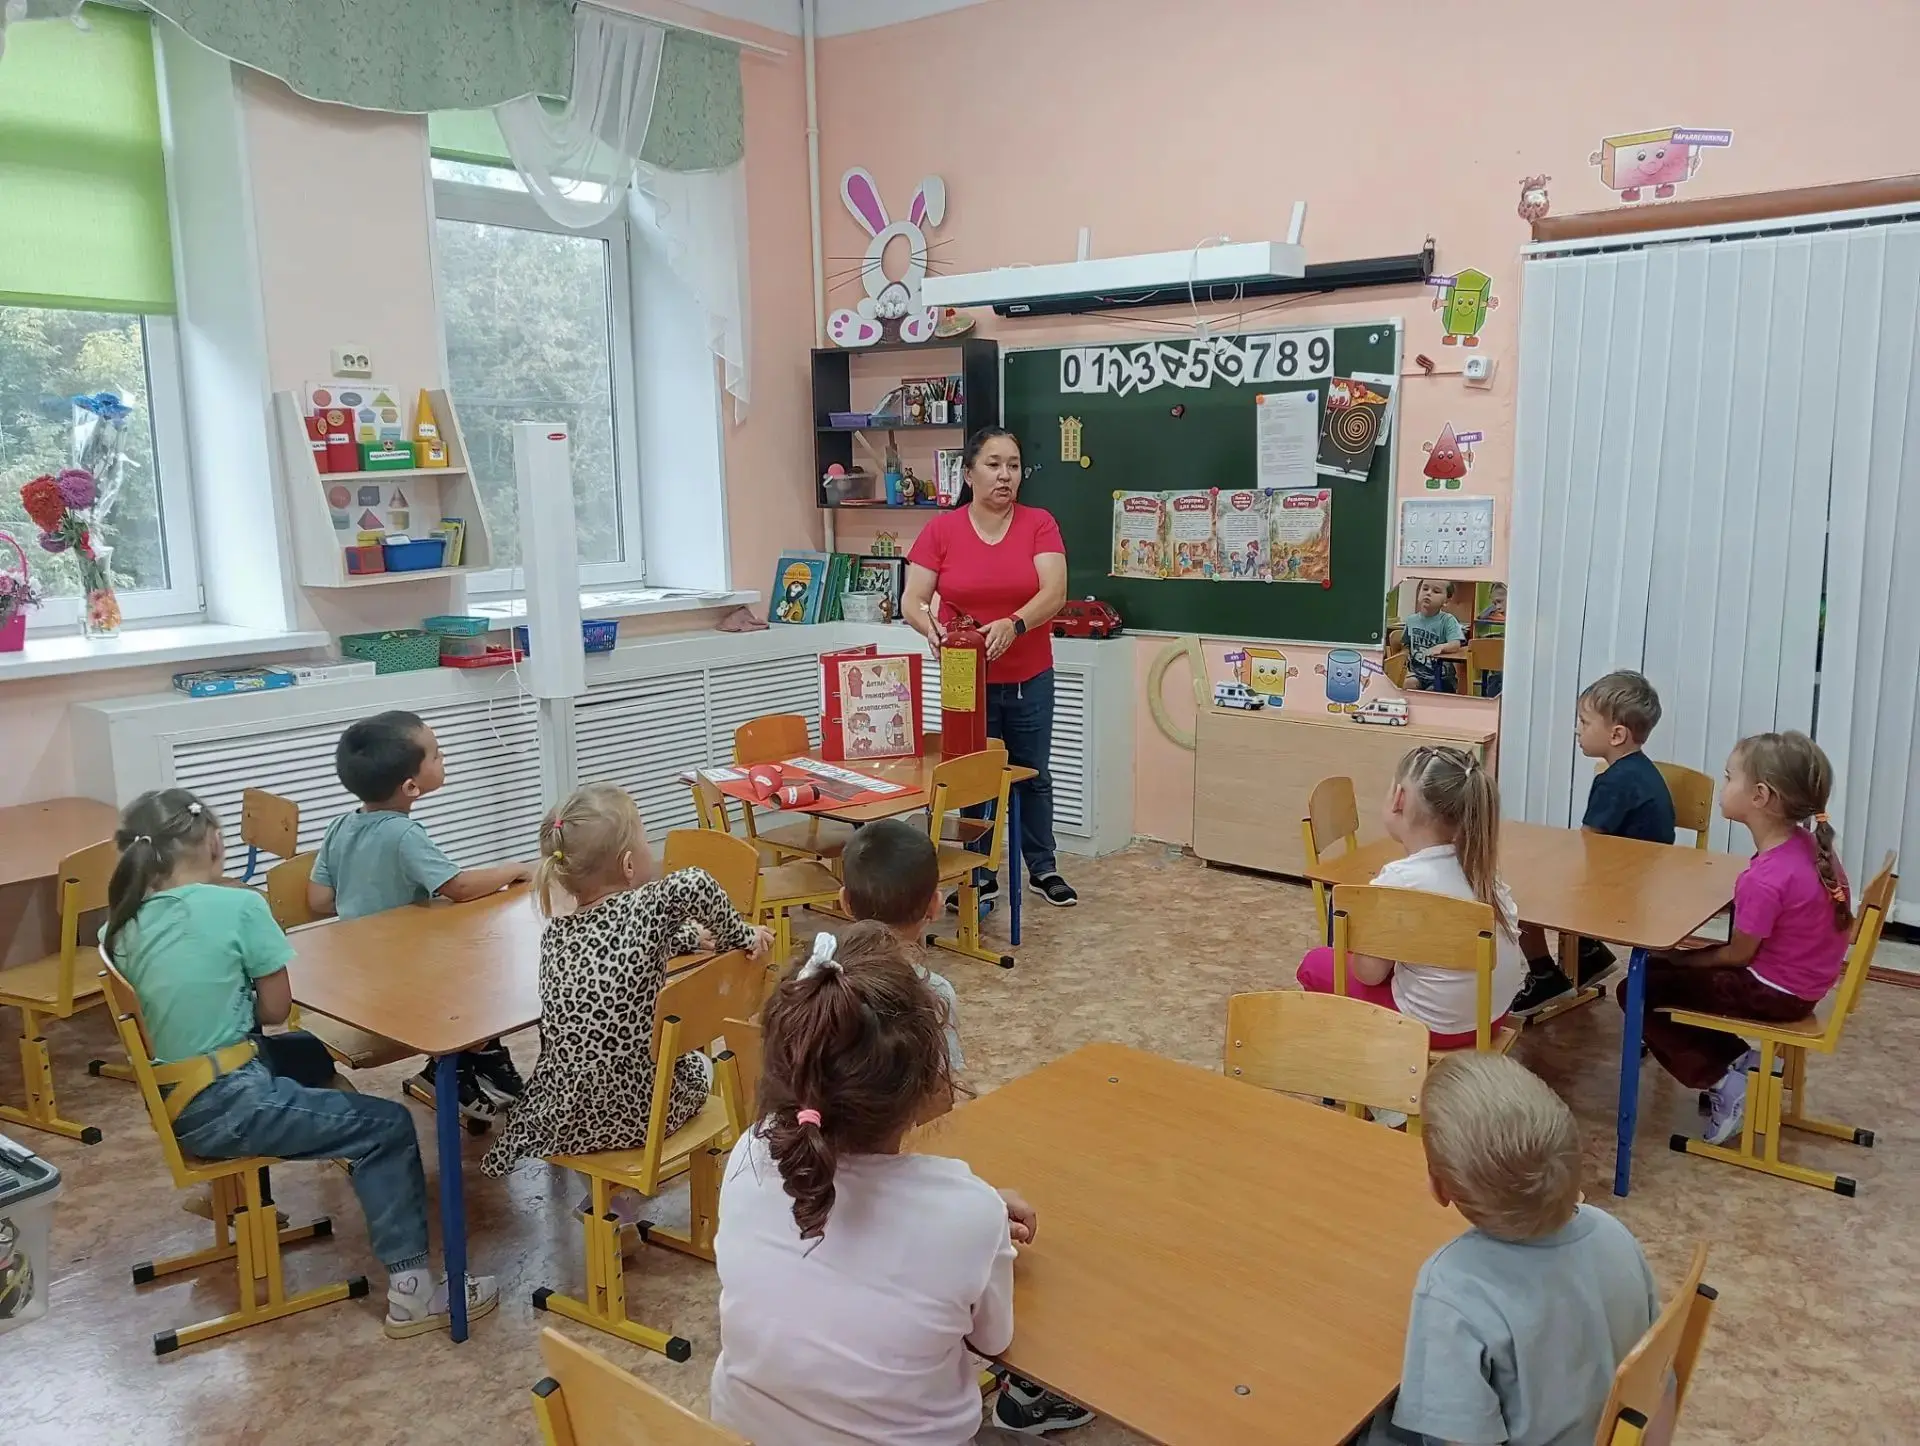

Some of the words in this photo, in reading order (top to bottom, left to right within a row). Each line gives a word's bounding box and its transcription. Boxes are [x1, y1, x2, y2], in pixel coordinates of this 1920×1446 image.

[1063, 354, 1082, 388] 0
[1091, 352, 1104, 386] 1
[1108, 358, 1133, 393] 2
[1133, 351, 1156, 385] 3
[1160, 353, 1188, 380] 4
[1188, 351, 1211, 383] 5
[1214, 352, 1244, 379] 6
[1250, 342, 1272, 379] 7
[1276, 339, 1299, 377] 8
[1308, 336, 1332, 374] 9
